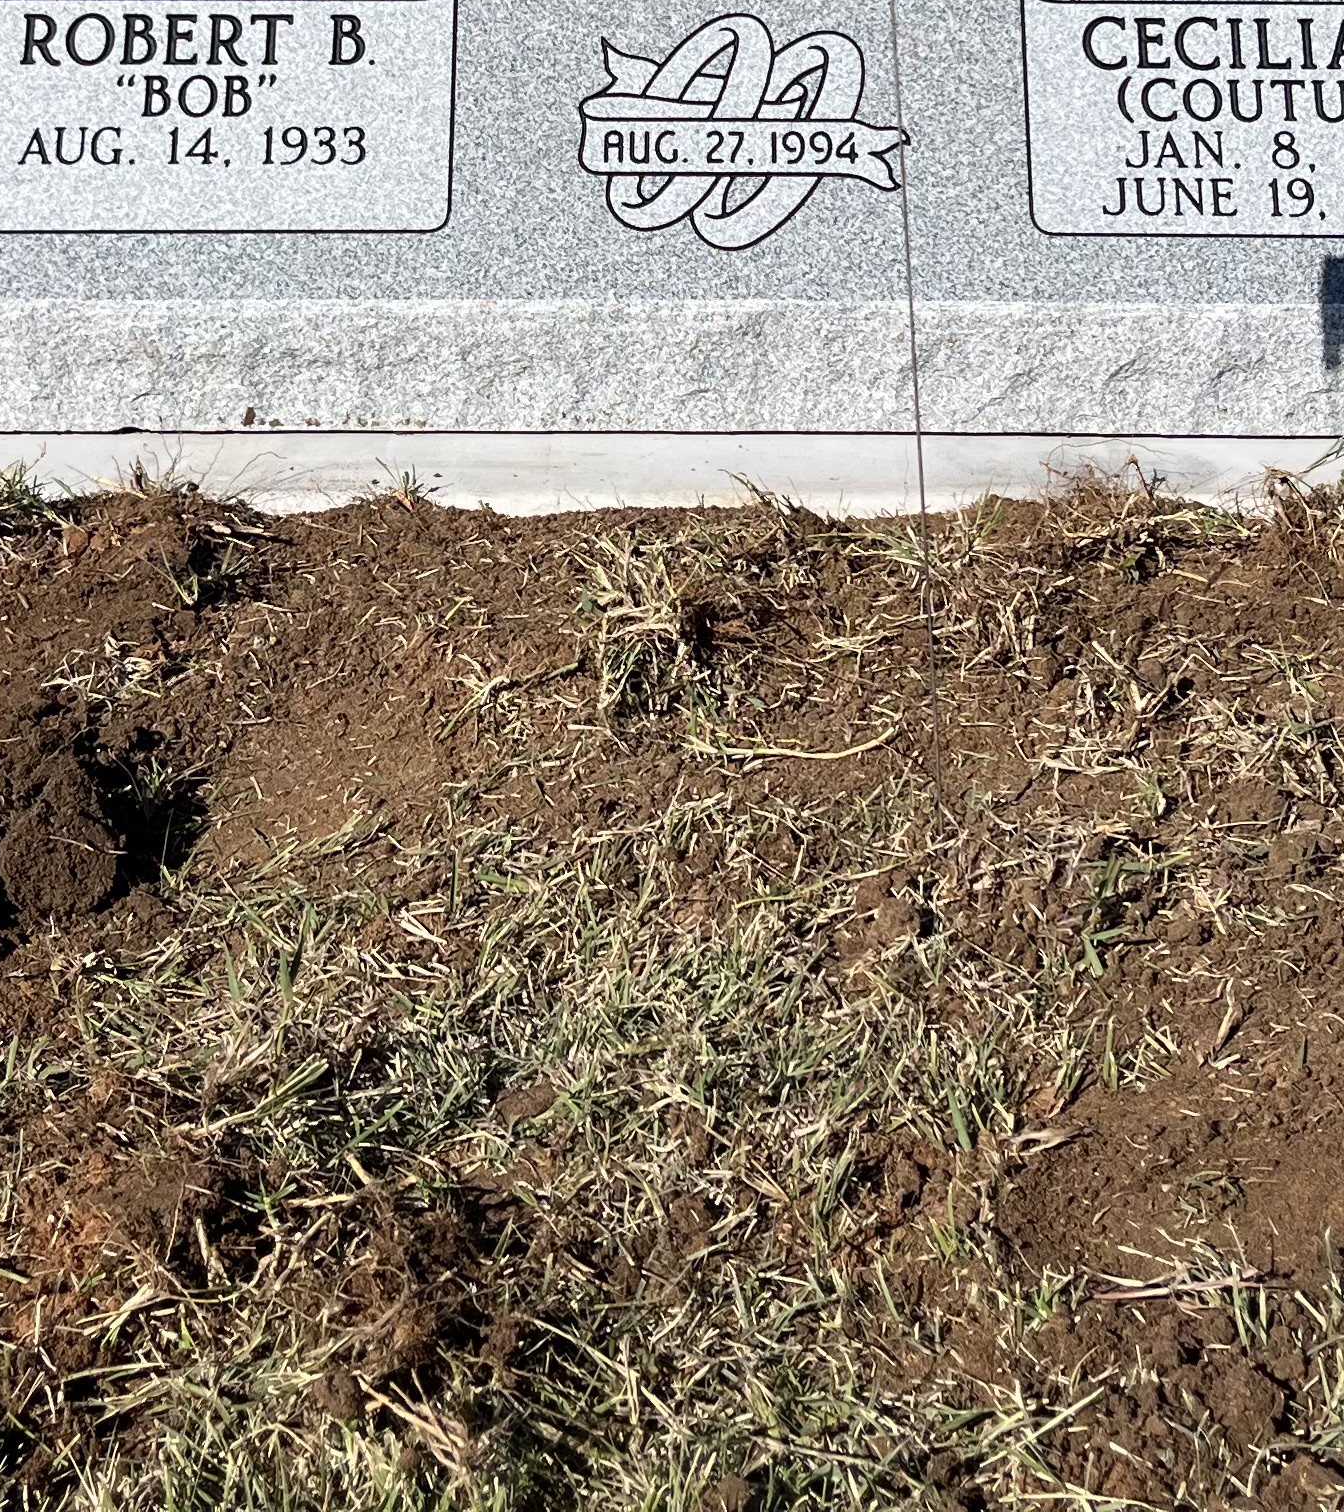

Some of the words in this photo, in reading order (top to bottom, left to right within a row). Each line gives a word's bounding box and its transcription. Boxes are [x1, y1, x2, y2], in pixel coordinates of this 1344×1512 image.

[20, 13, 293, 66] ROBERT
[328, 15, 375, 65] B.
[18, 127, 136, 165] AUG.
[168, 127, 230, 167] 14,
[263, 127, 365, 165] 1933
[604, 130, 689, 164] AUG.
[707, 131, 754, 166] 27,
[771, 131, 858, 164] 1994
[1126, 131, 1241, 168] JAN.
[1272, 131, 1315, 172] 8,
[1103, 178, 1237, 216] JUNE
[1269, 178, 1325, 220] 19,
